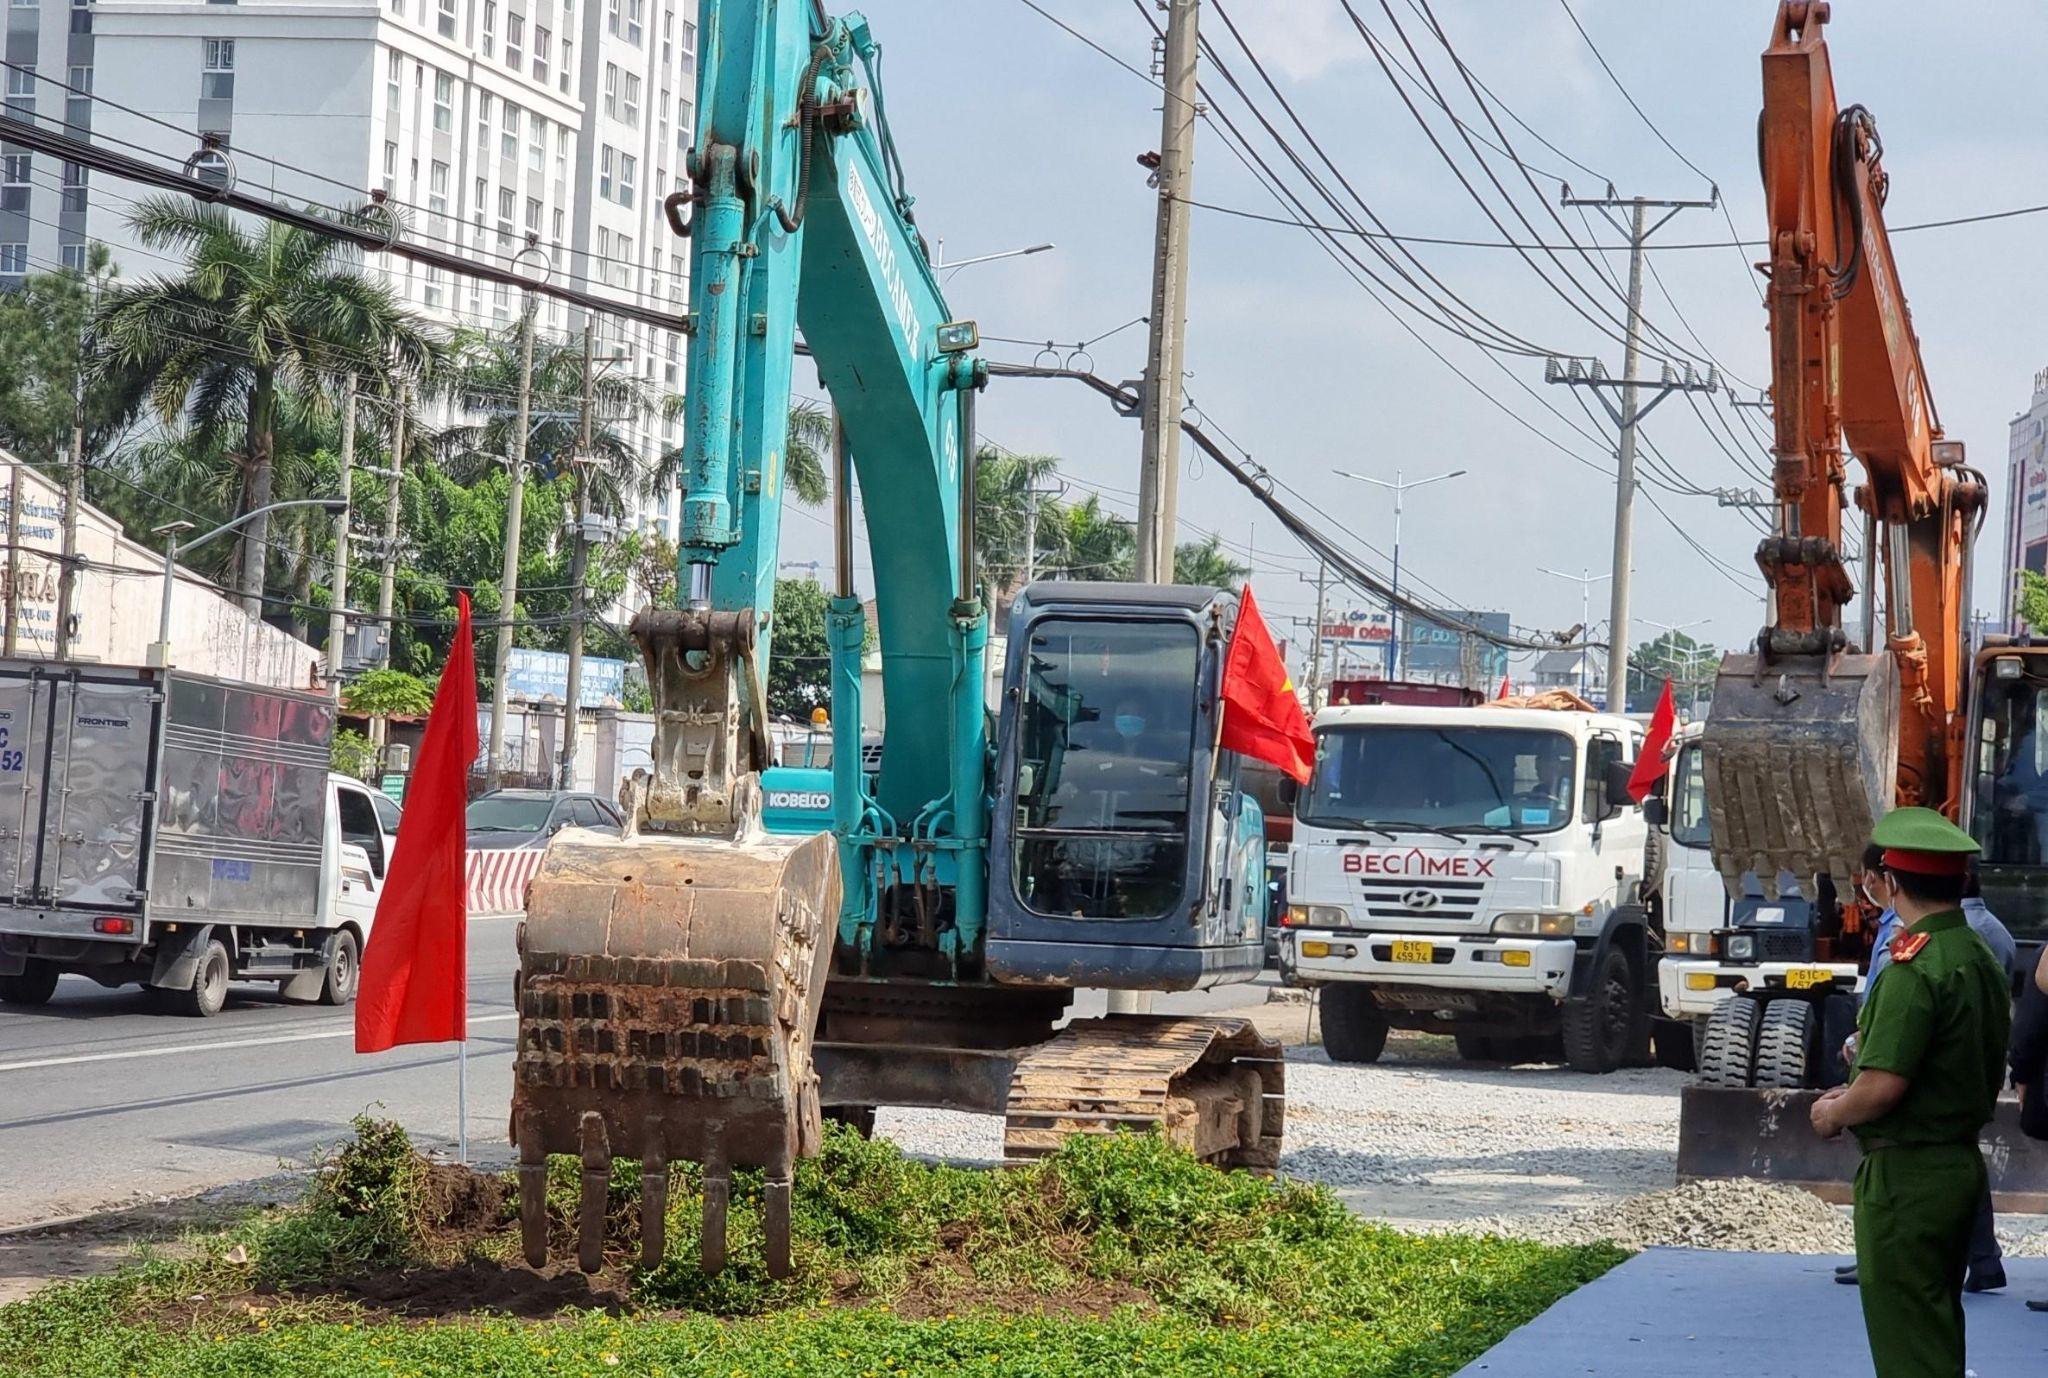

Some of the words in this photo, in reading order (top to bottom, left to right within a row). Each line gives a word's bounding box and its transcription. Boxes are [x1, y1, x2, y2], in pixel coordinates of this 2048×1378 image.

[78, 717, 129, 728] FRONTIER
[769, 792, 830, 808] KOBELCO
[1343, 847, 1495, 877] BECAMEX
